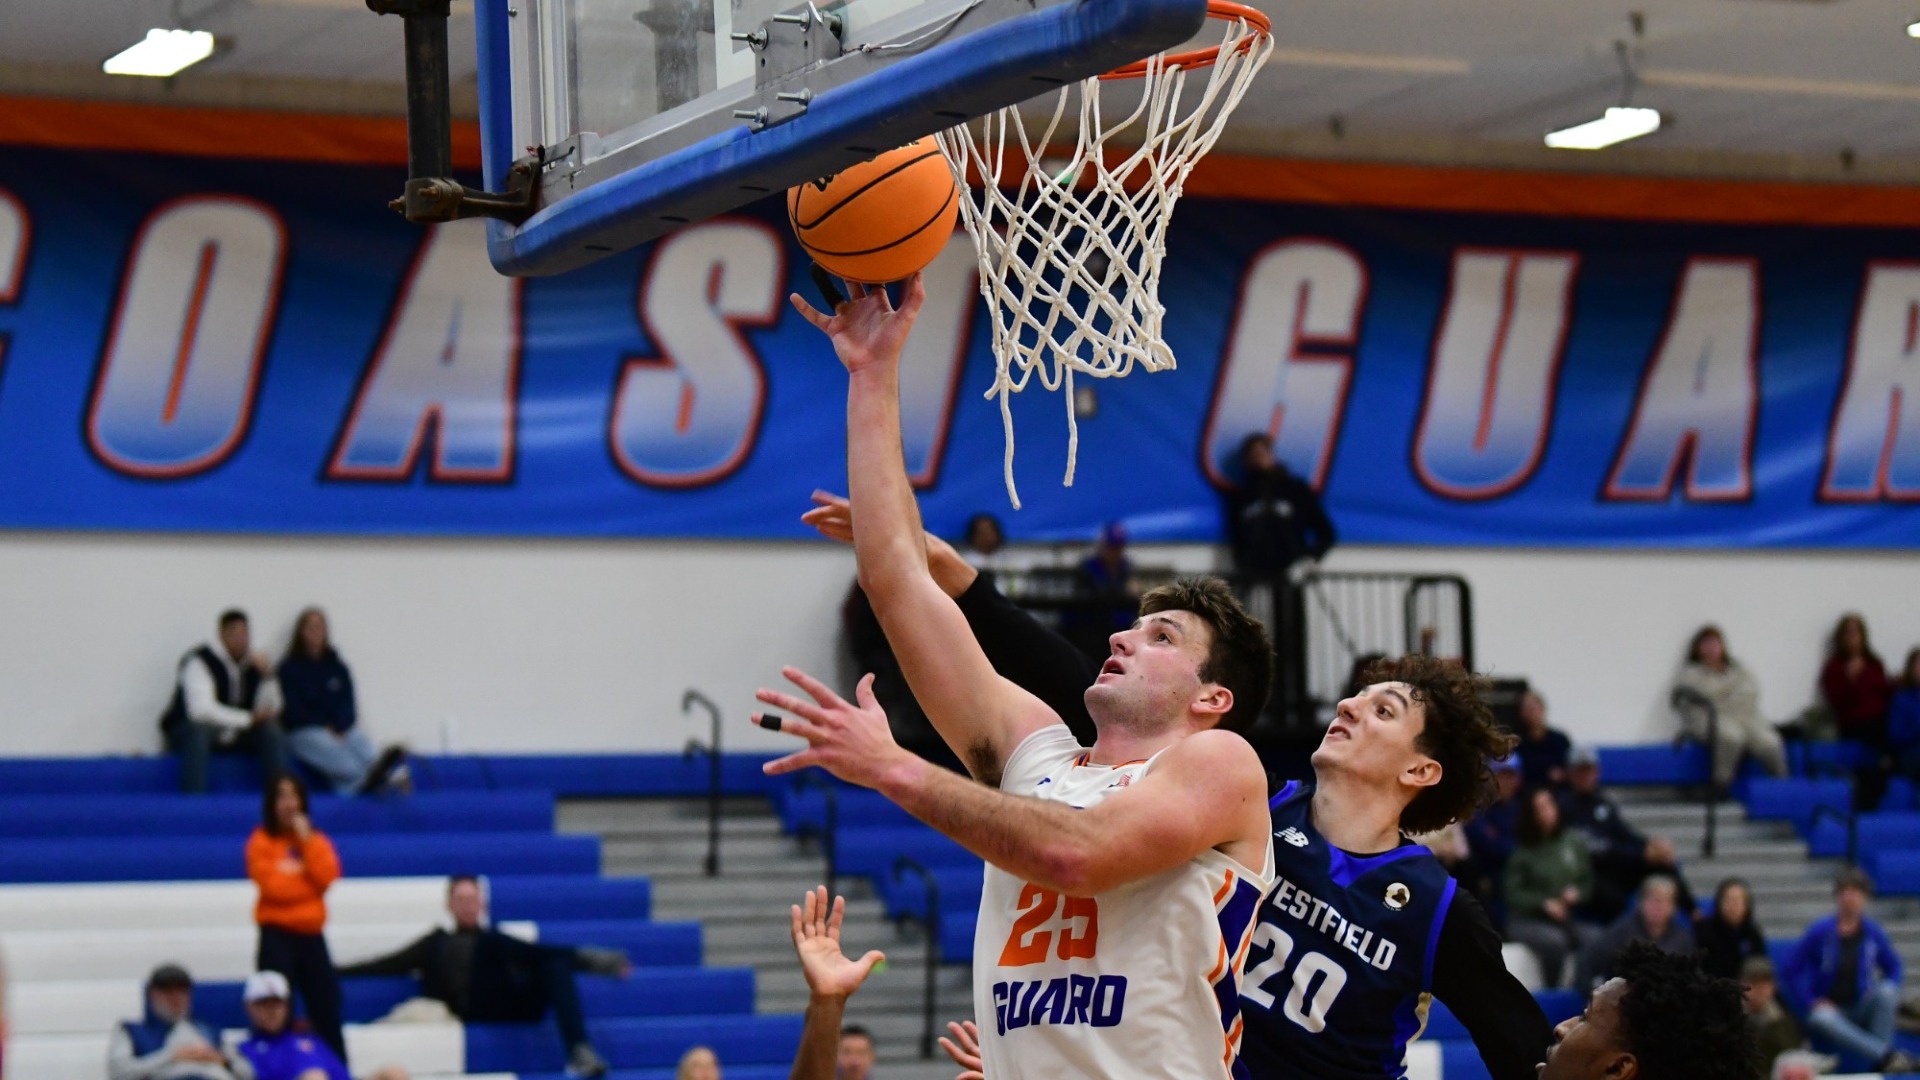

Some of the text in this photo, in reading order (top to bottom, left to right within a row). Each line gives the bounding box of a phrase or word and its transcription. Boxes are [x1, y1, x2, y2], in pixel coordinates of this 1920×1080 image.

[998, 881, 1098, 966] 25
[993, 974, 1127, 1036] GUARD
[1239, 921, 1347, 1033] 20
